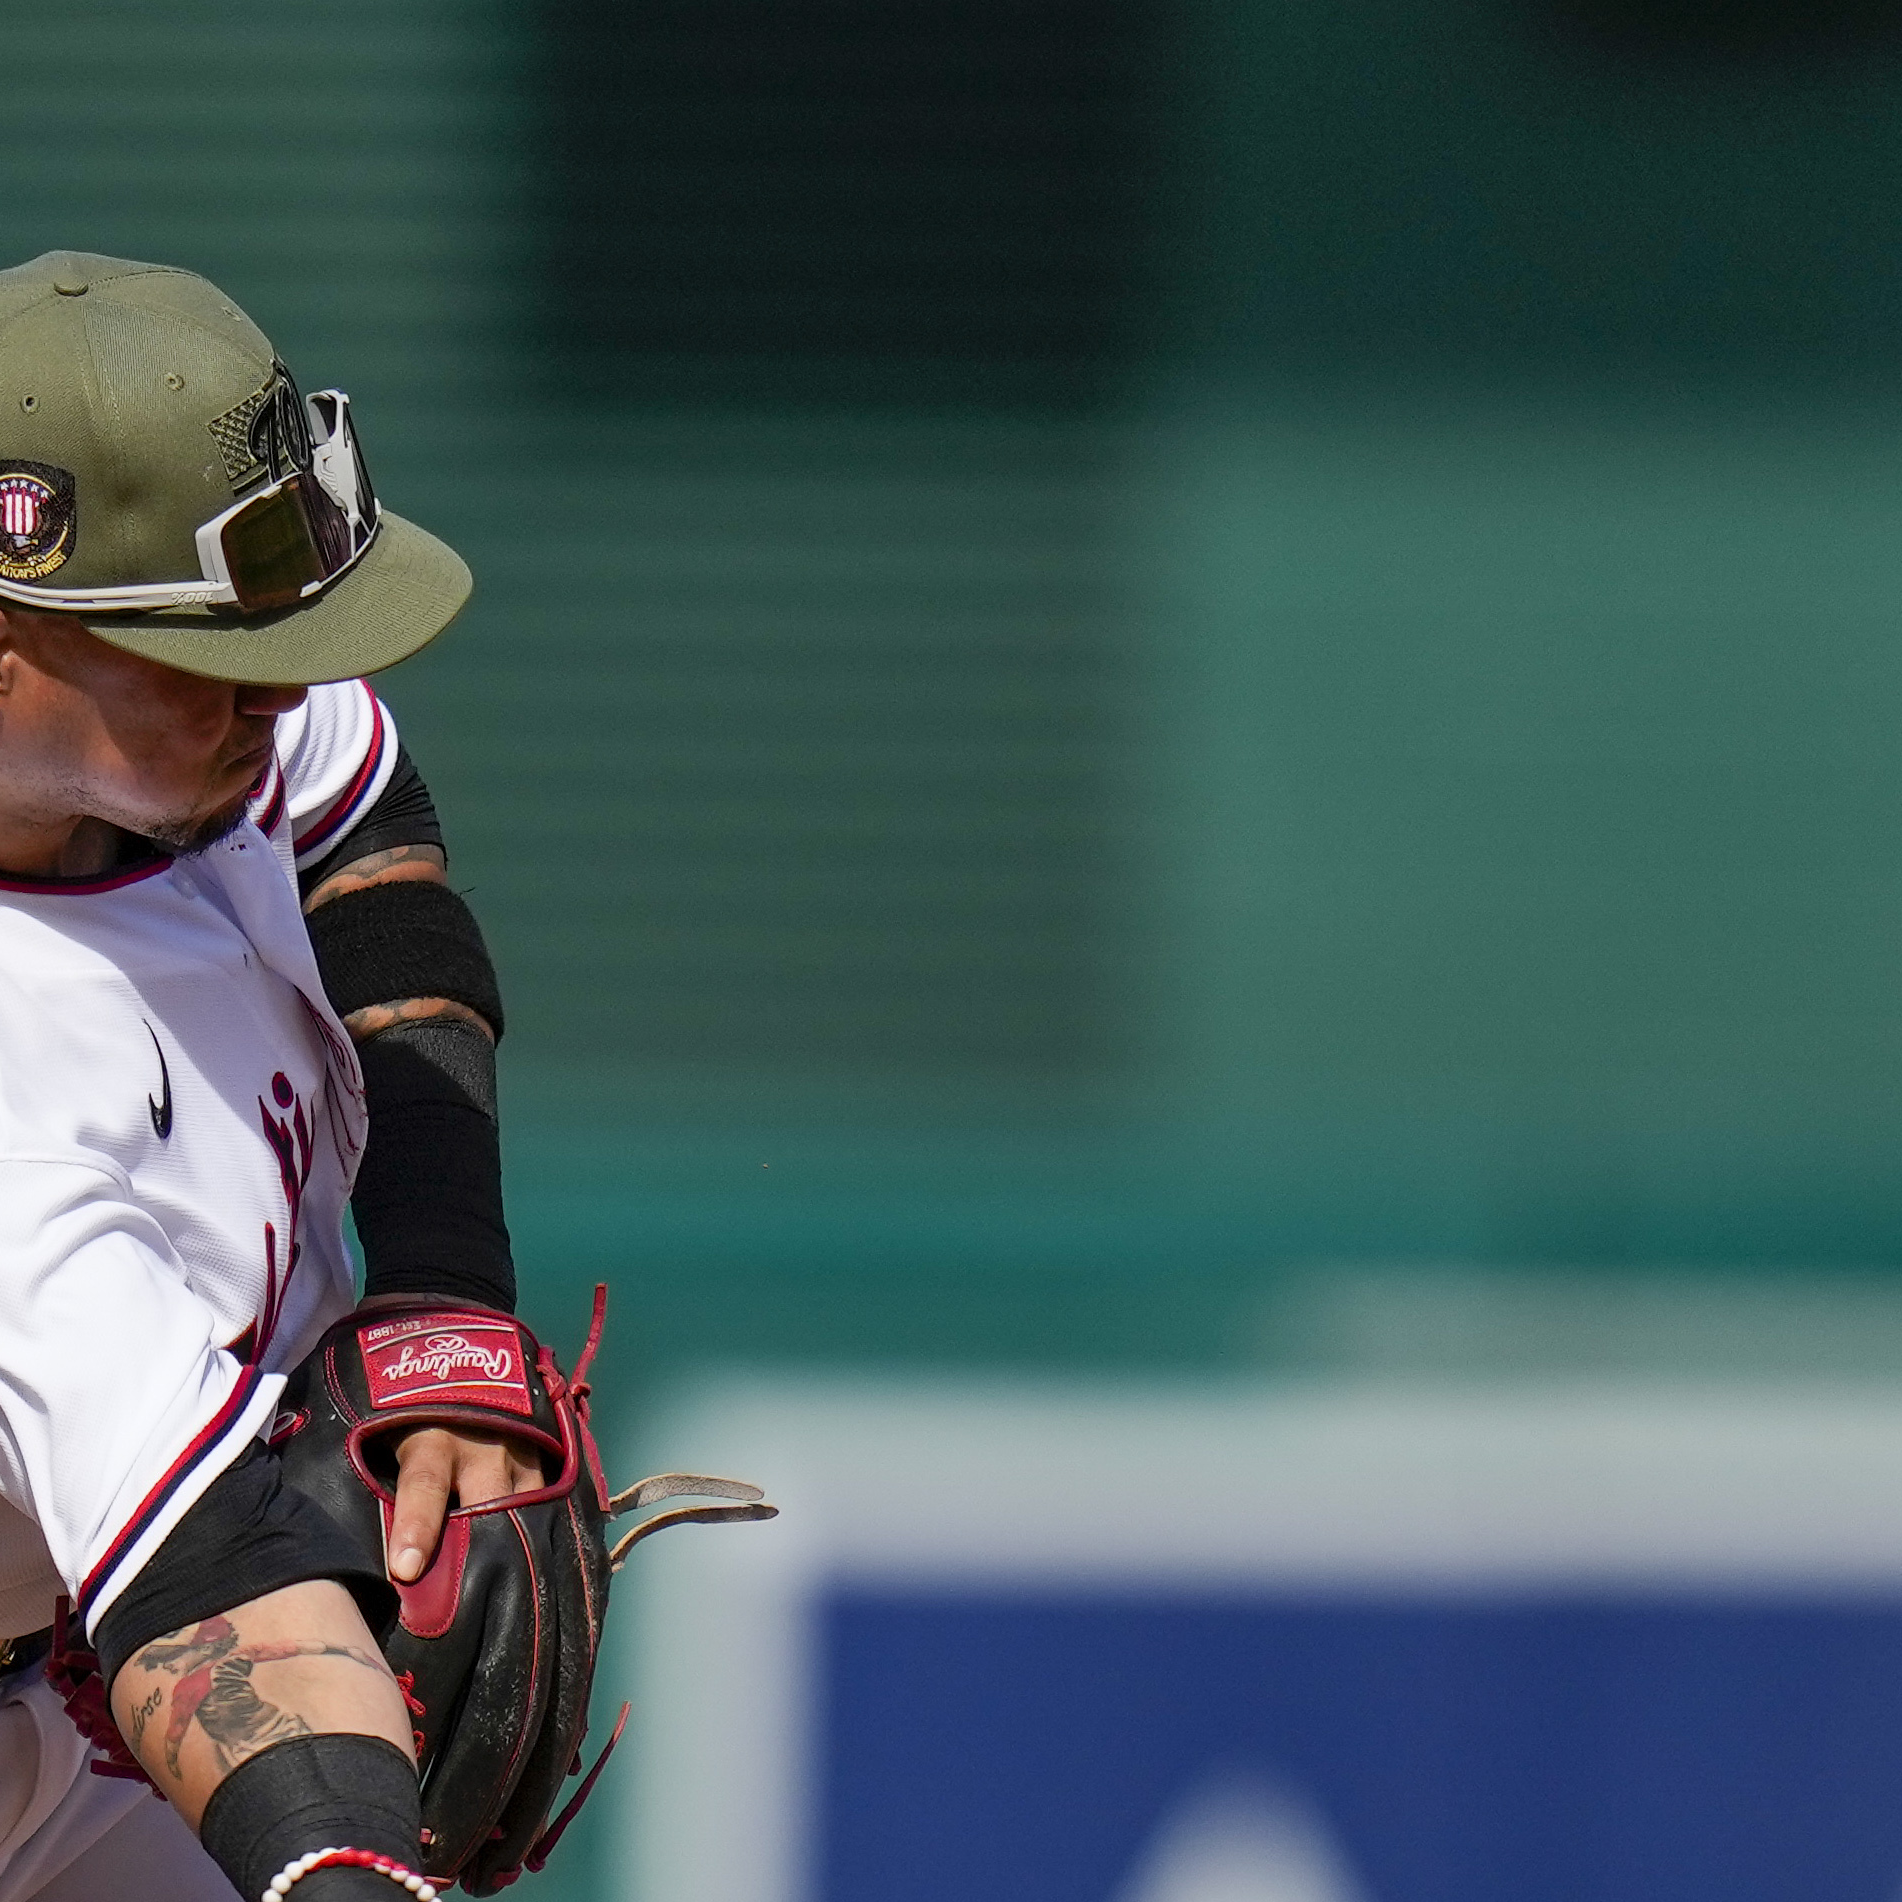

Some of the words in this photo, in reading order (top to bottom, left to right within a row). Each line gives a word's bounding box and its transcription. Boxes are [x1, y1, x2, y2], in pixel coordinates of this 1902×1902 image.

[35, 549, 68, 577] FINEST
[366, 1322, 396, 1342] 1887
[381, 1345, 512, 1381] Rawlings
